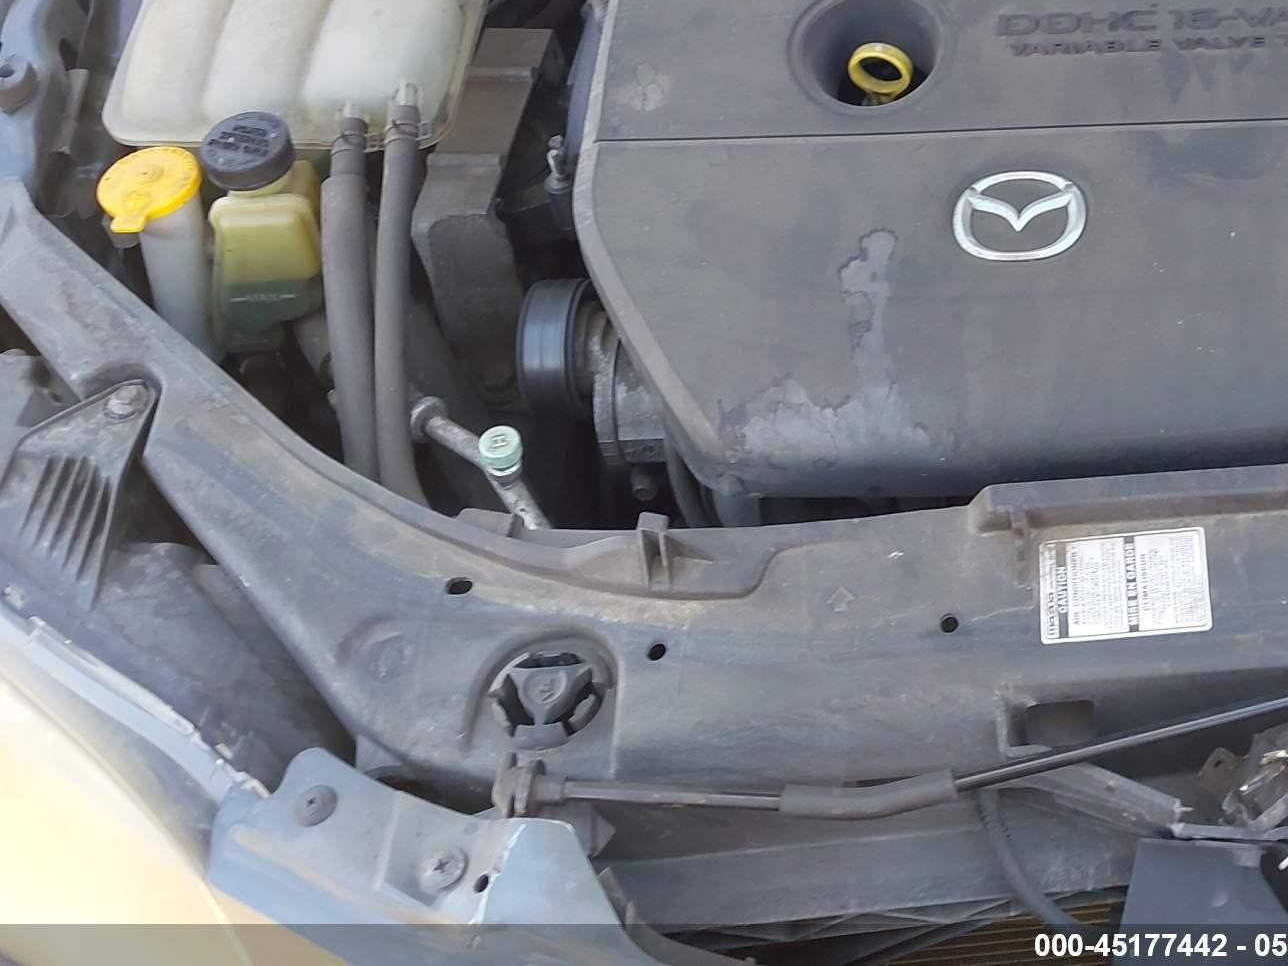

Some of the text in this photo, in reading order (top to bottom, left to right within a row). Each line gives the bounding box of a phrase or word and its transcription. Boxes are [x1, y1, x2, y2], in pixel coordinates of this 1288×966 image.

[997, 7, 1158, 35] DOHC
[1008, 38, 1160, 56] VARIABLE
[1171, 35, 1266, 50] VALVE
[1056, 566, 1068, 615] CAUTION
[1126, 582, 1138, 597] EN
